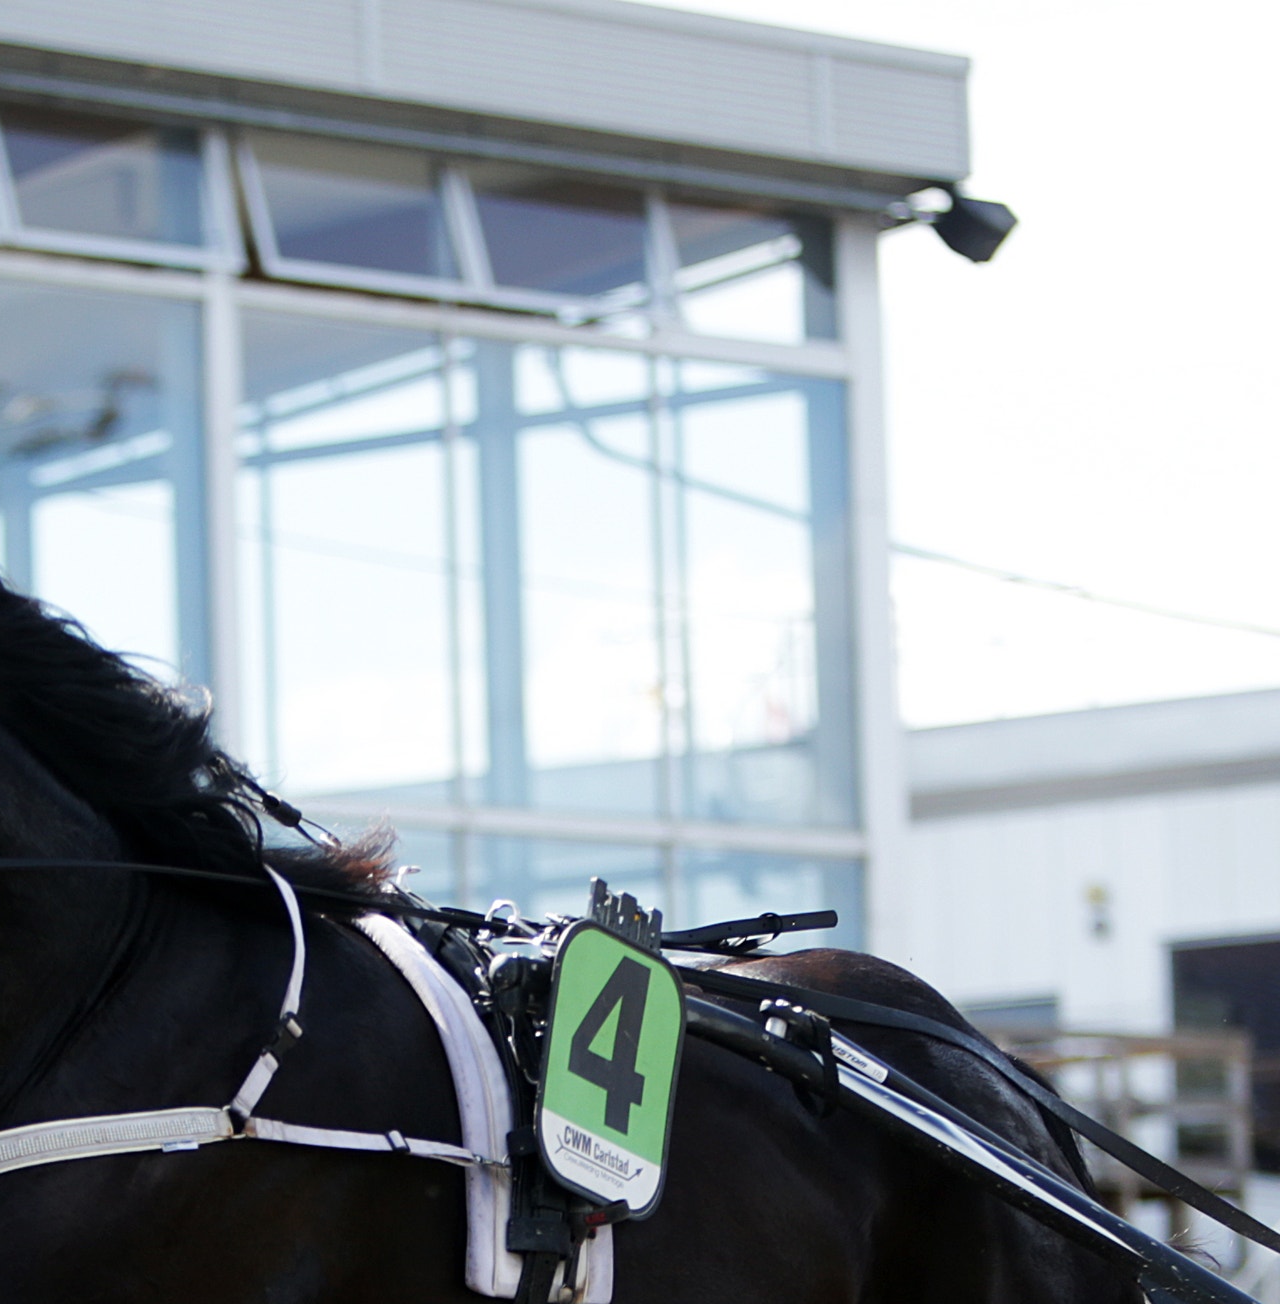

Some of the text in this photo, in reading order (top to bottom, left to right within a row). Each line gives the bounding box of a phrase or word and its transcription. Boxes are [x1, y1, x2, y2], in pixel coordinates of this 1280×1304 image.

[567, 955, 651, 1136] 4
[564, 1125, 592, 1156] CWM
[593, 1142, 630, 1175] Carlstad
